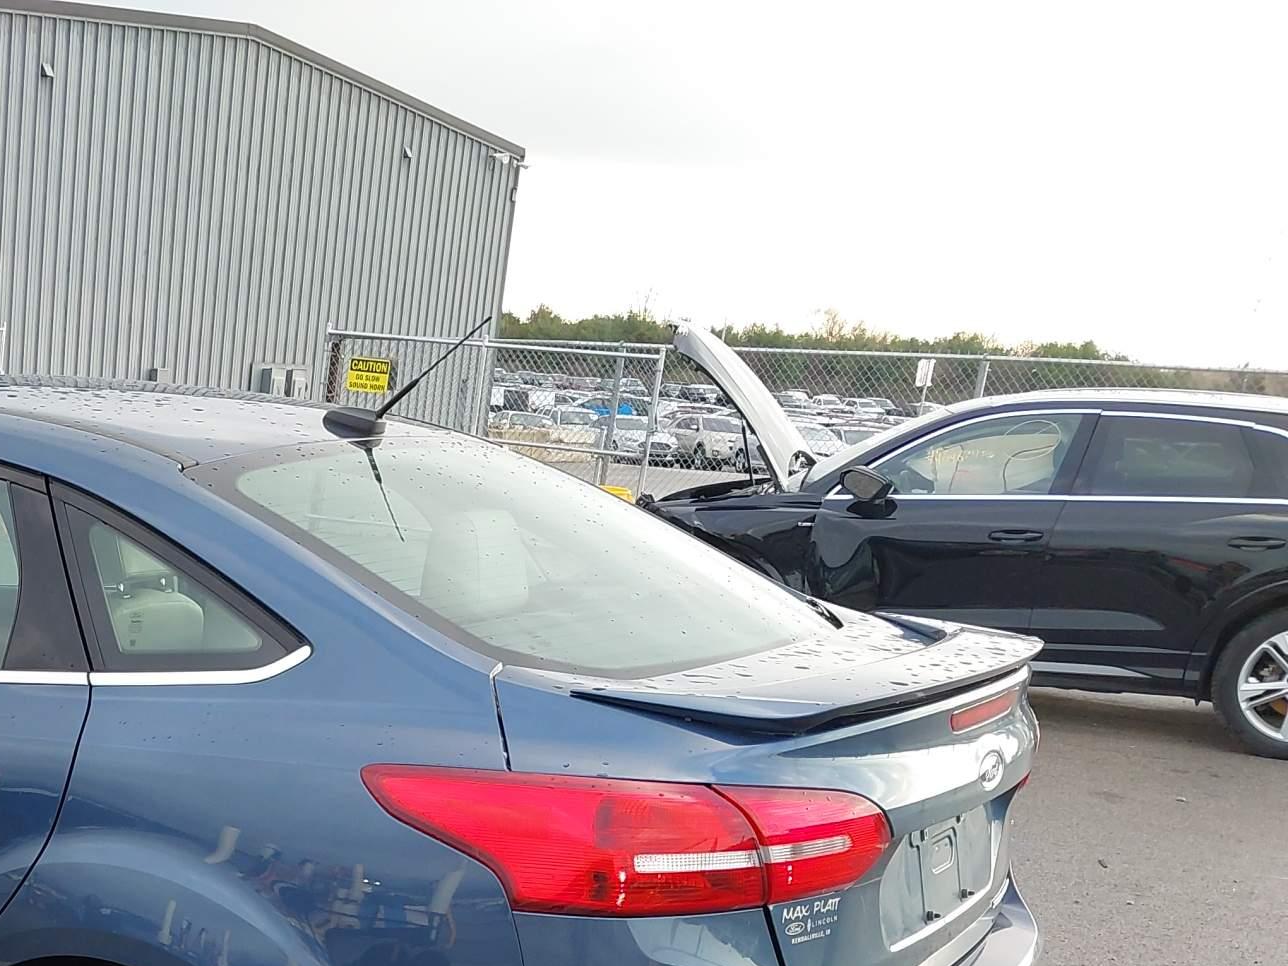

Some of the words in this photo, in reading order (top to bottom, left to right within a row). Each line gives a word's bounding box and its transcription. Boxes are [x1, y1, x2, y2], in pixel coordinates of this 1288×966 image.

[352, 361, 387, 372] CAUTION
[781, 904, 811, 924] MAX
[813, 897, 841, 915] PLATT
[811, 915, 838, 928] LINCOLN
